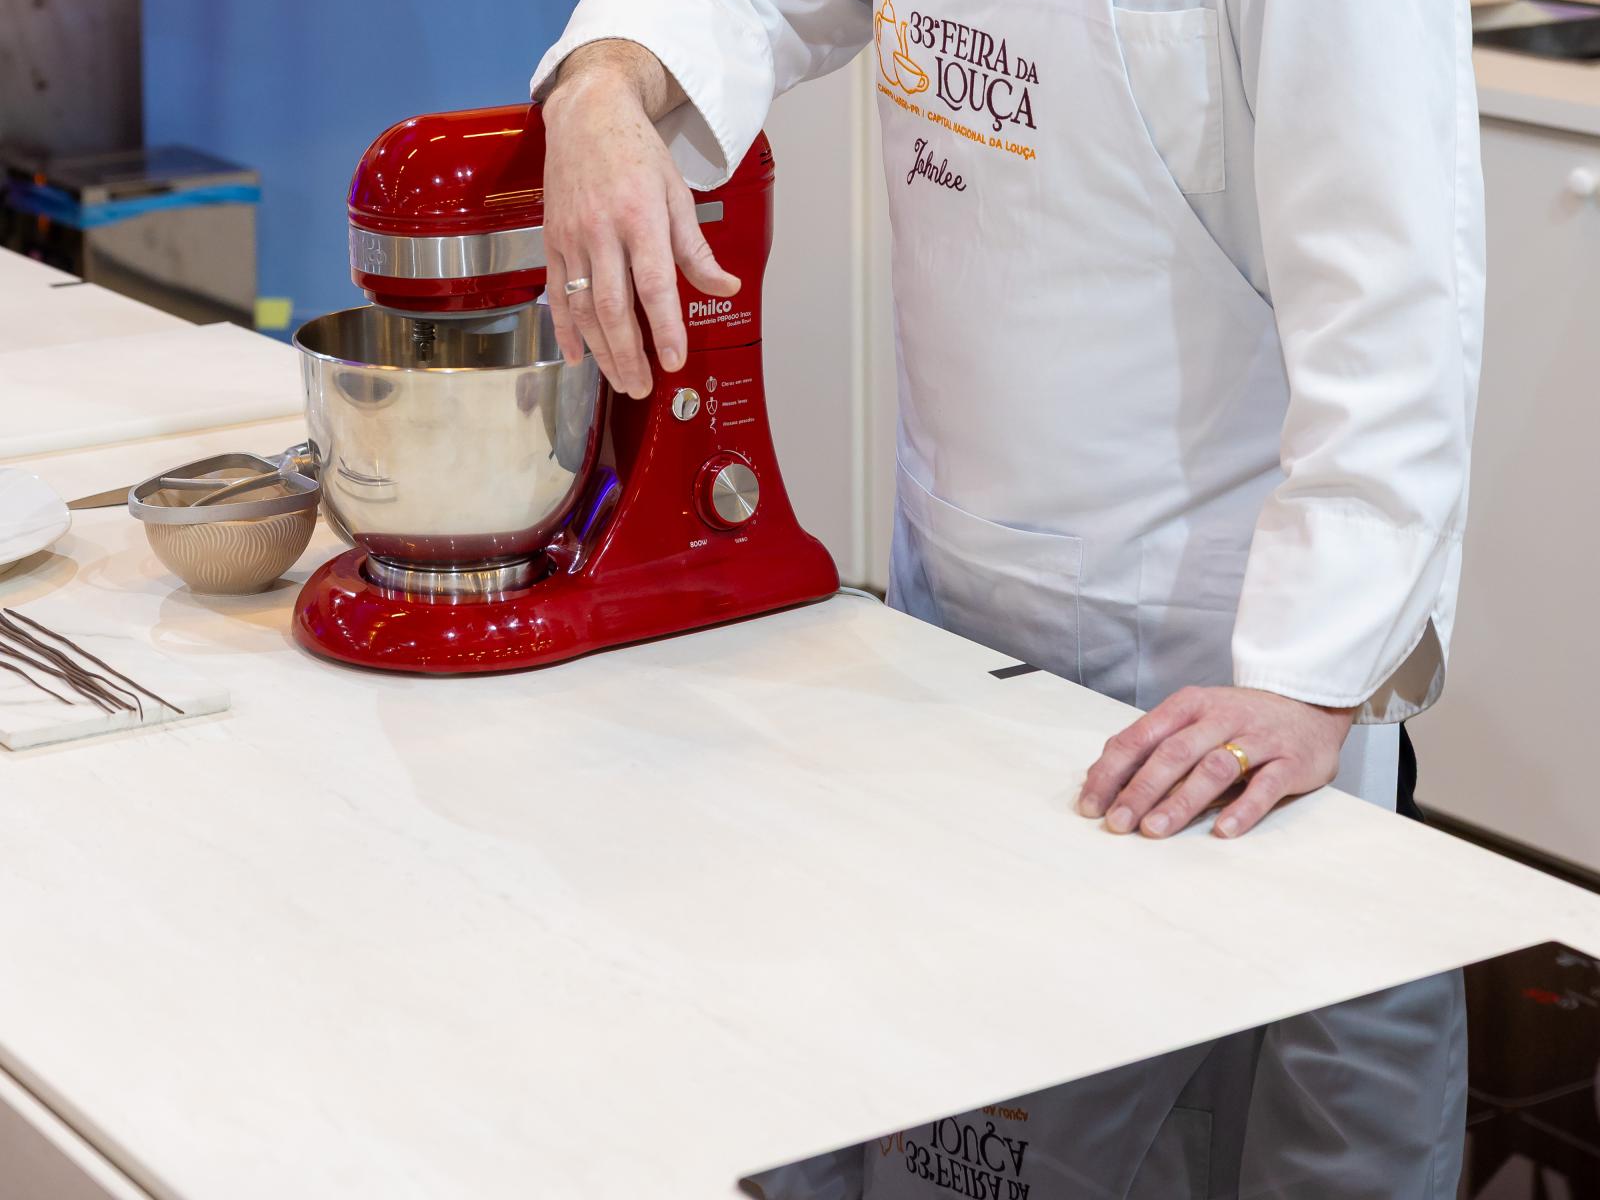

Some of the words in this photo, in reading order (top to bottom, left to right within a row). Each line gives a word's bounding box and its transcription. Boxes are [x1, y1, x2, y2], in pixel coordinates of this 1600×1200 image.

[940, 19, 1011, 76] FEIRA
[1015, 57, 1039, 84] DA
[935, 56, 1037, 131] LOUÇA
[989, 136, 1002, 149] DA
[1005, 139, 1036, 160] LOUÇA
[688, 298, 732, 318] Philco
